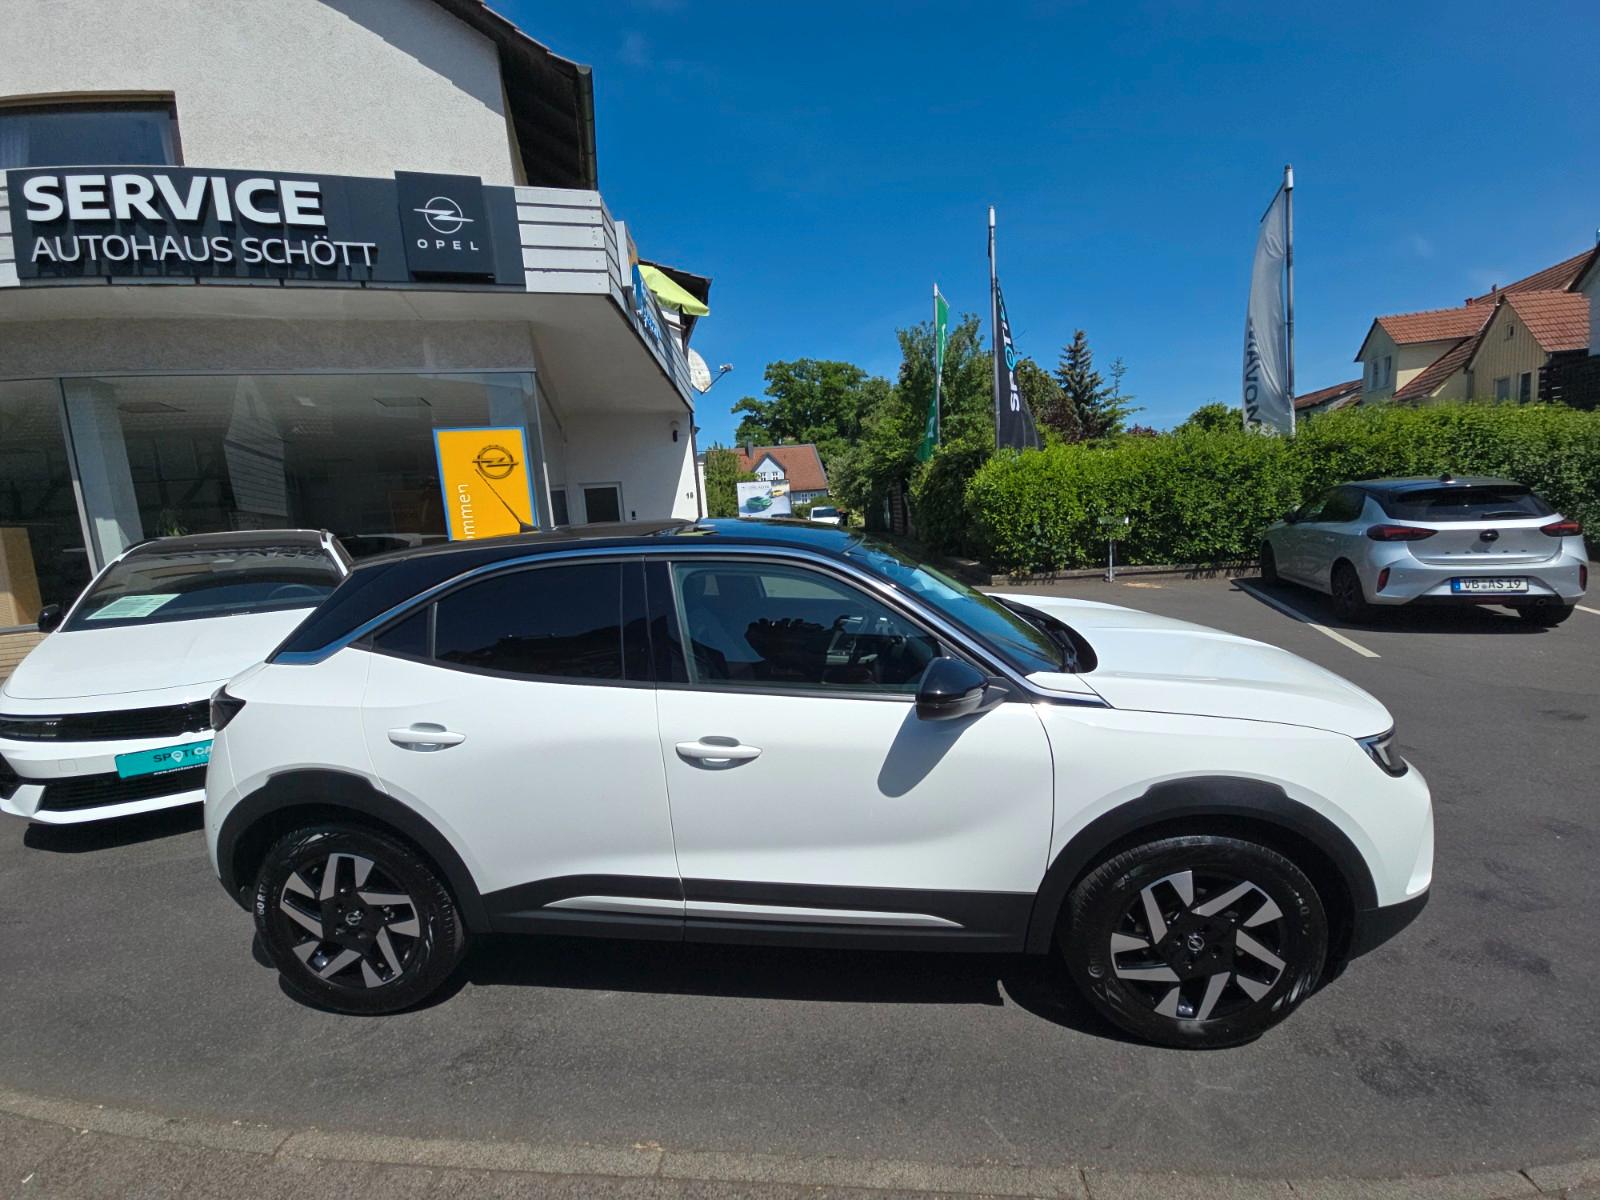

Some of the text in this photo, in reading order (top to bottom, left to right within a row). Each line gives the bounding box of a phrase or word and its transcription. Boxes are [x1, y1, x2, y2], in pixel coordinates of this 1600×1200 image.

[22, 174, 326, 226] SERVICE
[31, 233, 376, 267] AUTOHAUS SCHÖTT
[416, 238, 479, 251] OPEL
[1463, 579, 1521, 589] VB AS 19
